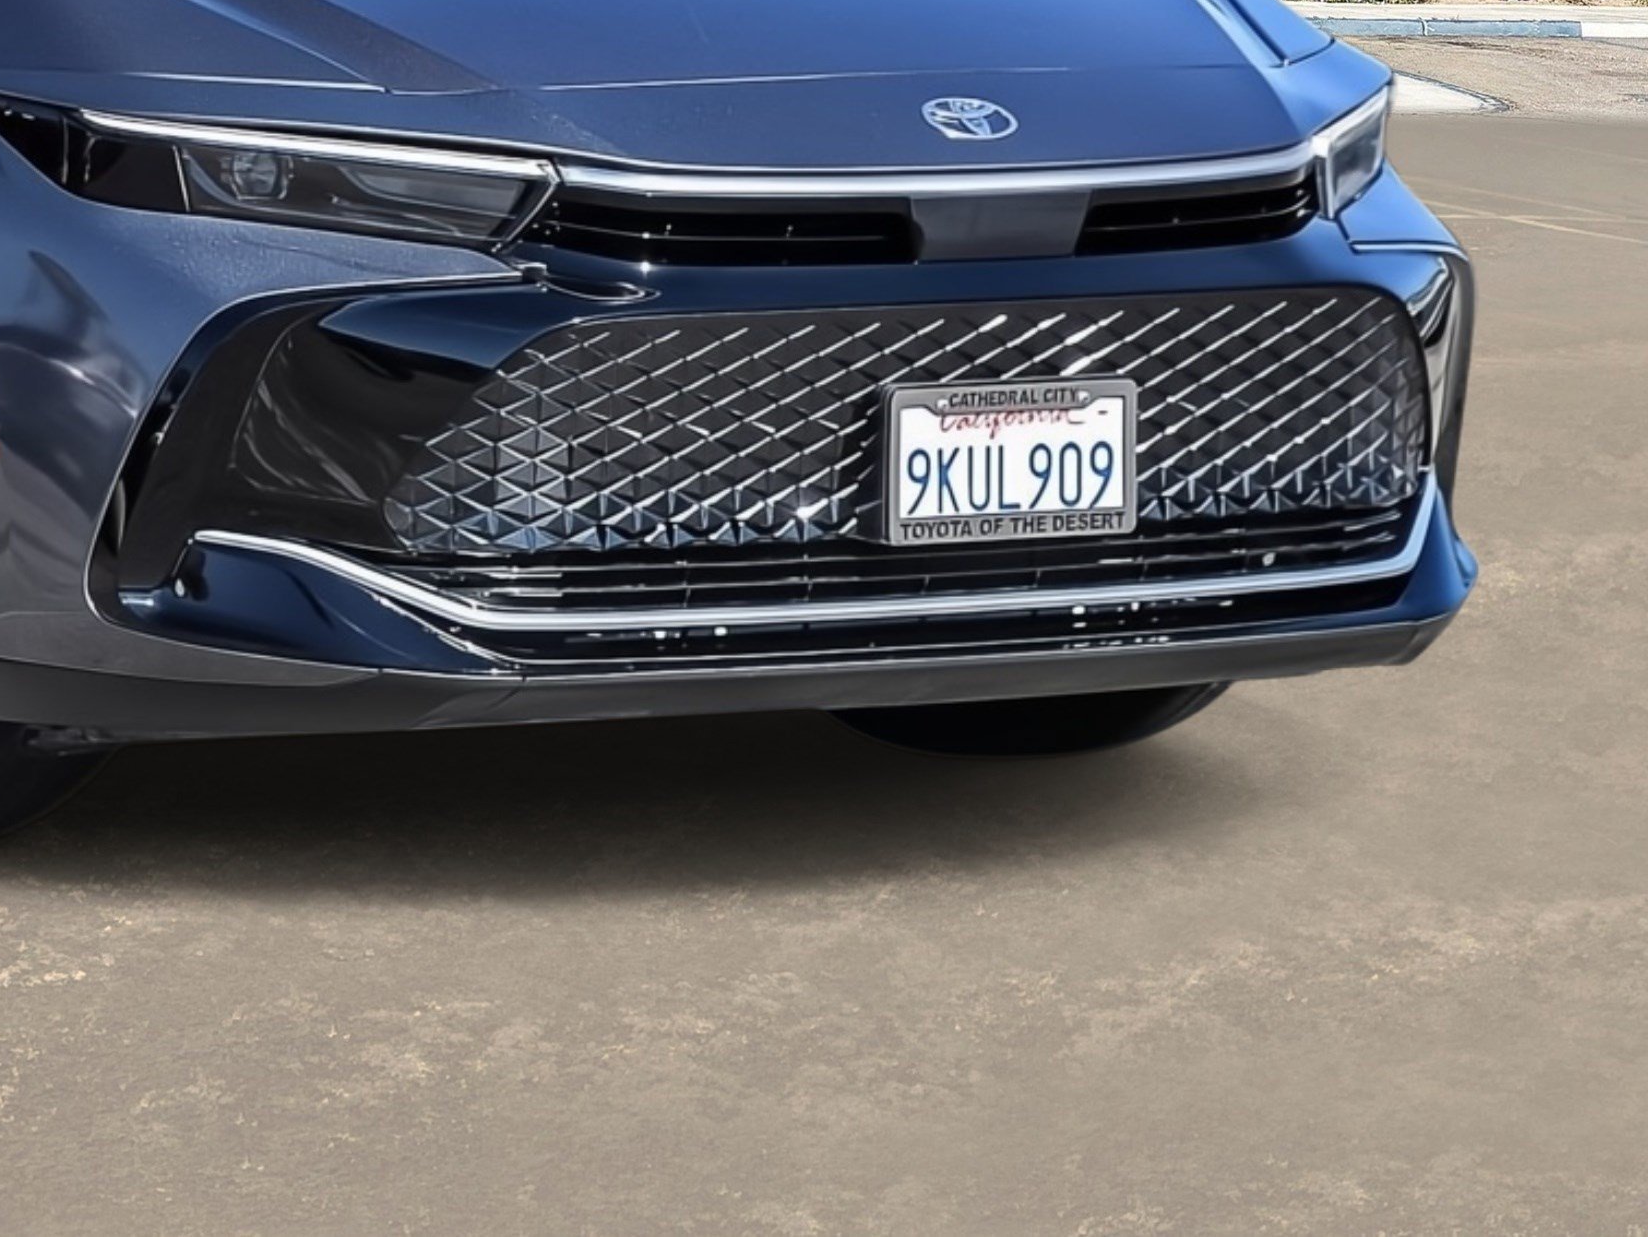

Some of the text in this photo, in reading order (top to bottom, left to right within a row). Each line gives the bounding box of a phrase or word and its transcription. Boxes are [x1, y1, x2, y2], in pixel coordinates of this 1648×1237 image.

[949, 388, 1077, 407] CATHEDRAL CITY
[906, 441, 1114, 516] 9KUL909
[900, 512, 1126, 541] TOYOTA OF THE DESERT
